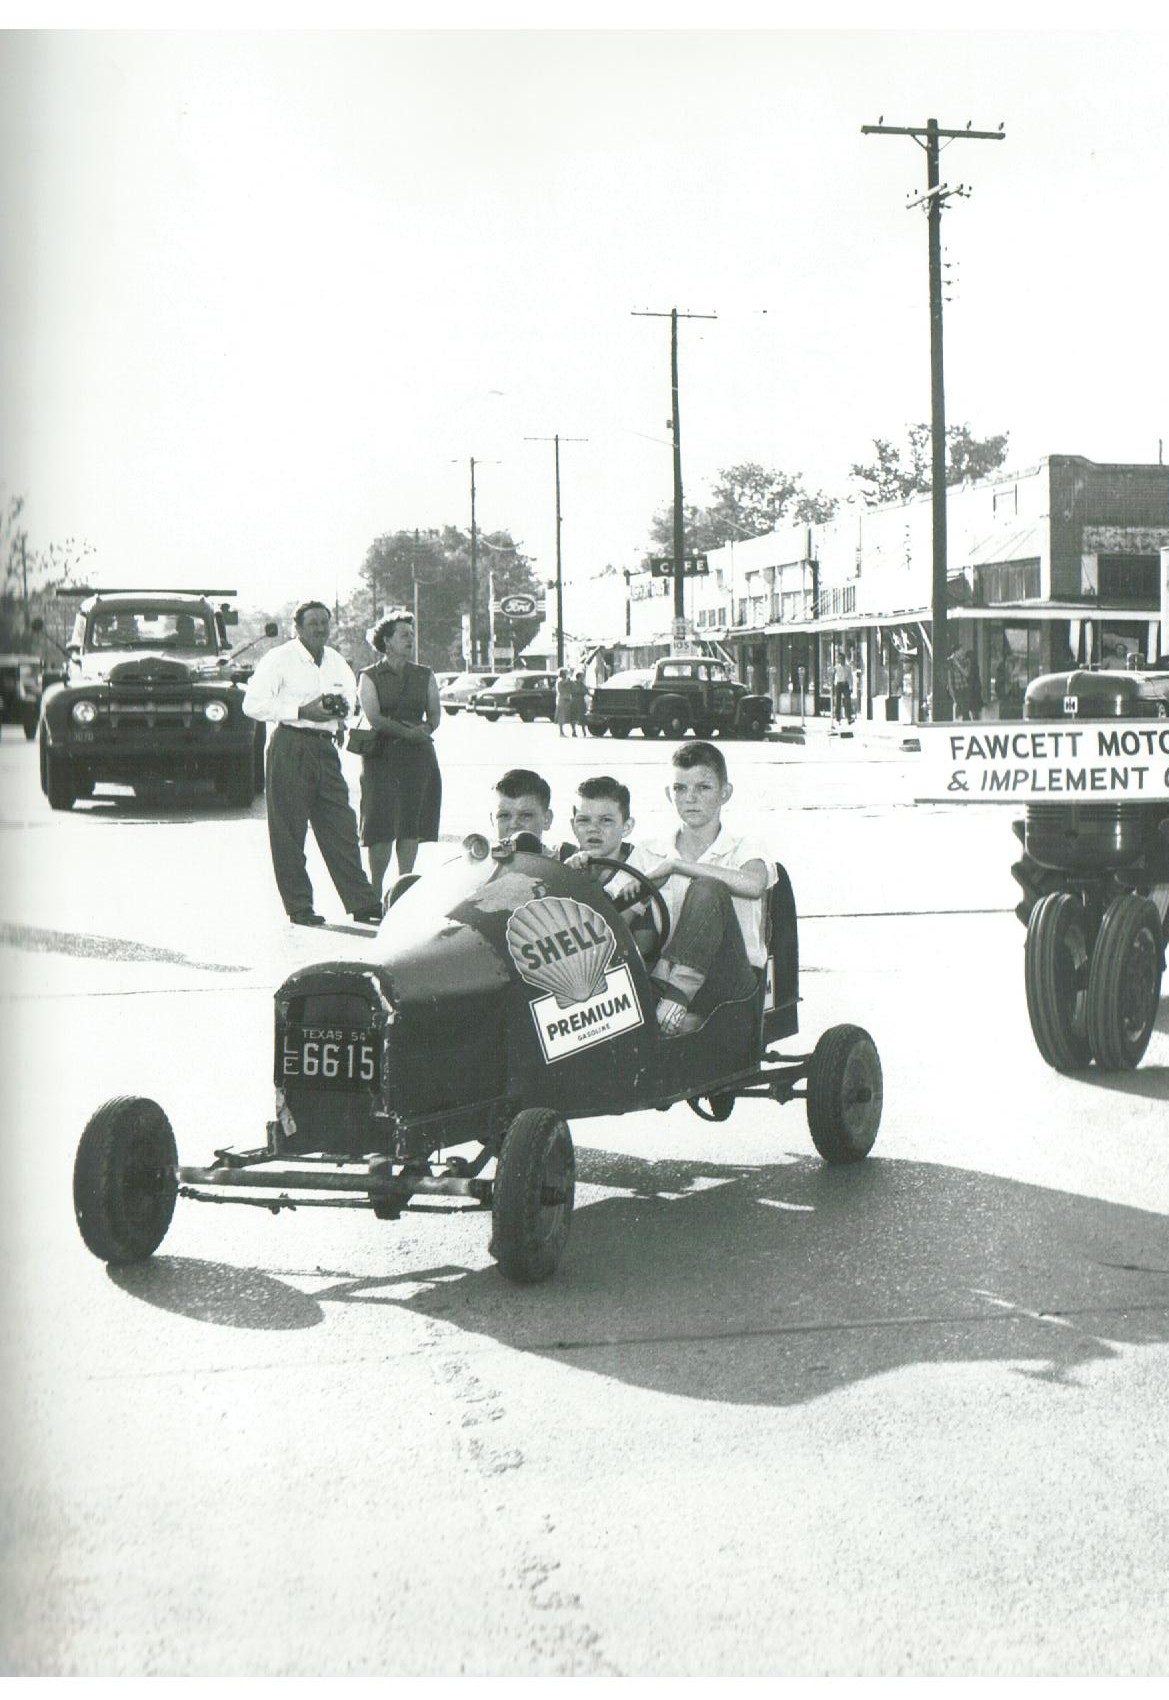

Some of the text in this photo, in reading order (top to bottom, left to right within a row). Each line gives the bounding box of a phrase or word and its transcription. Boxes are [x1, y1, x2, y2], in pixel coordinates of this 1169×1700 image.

[661, 560, 705, 573] CFE
[505, 598, 532, 612] Ford
[950, 732, 1083, 760] FAWCETT
[947, 770, 969, 792] &
[981, 767, 1149, 791] IMPLEMENT
[521, 921, 607, 970] SHELL
[546, 993, 631, 1041] PREMIUM
[302, 1029, 343, 1040] TEXAS
[577, 1023, 611, 1042] GASOLINE
[303, 1043, 375, 1080] 6615
